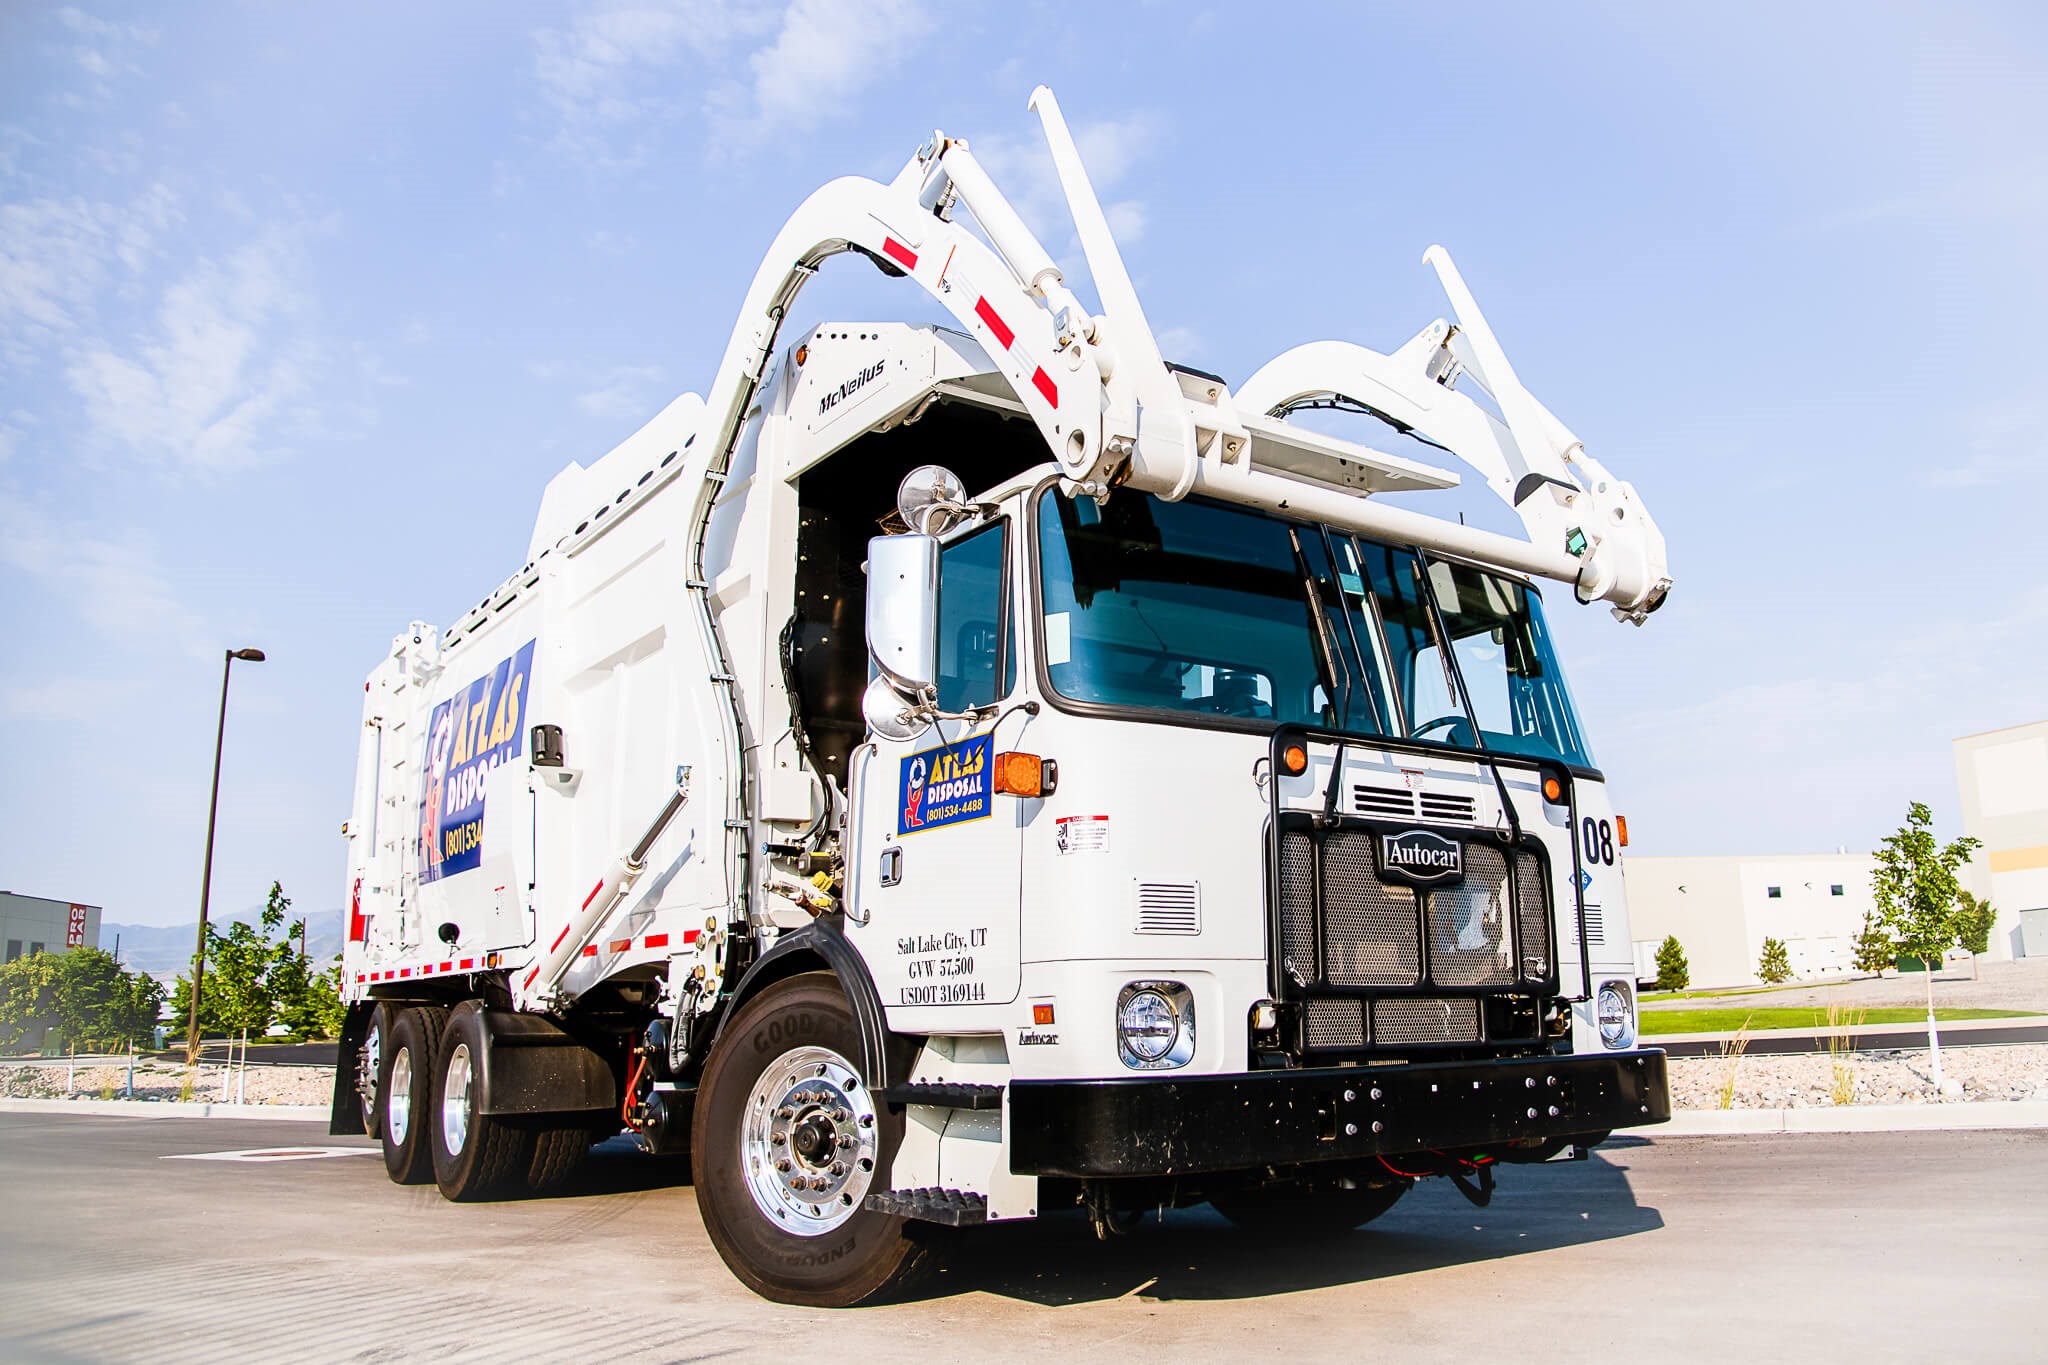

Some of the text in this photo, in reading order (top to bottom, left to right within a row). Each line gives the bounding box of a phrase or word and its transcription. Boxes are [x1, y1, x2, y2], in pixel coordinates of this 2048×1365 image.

[818, 359, 885, 416] McNeilus
[449, 671, 524, 772] ATLAS
[928, 744, 985, 785] ATLAS
[927, 774, 983, 805] DISPOSAL
[1388, 840, 1457, 868] Autocar
[1582, 816, 1615, 867] 08
[69, 908, 78, 944] PRO
[897, 927, 988, 955] Salt Lake City, UT
[908, 956, 974, 980] GVW 57,500
[900, 981, 986, 1005] USDOT 3169144
